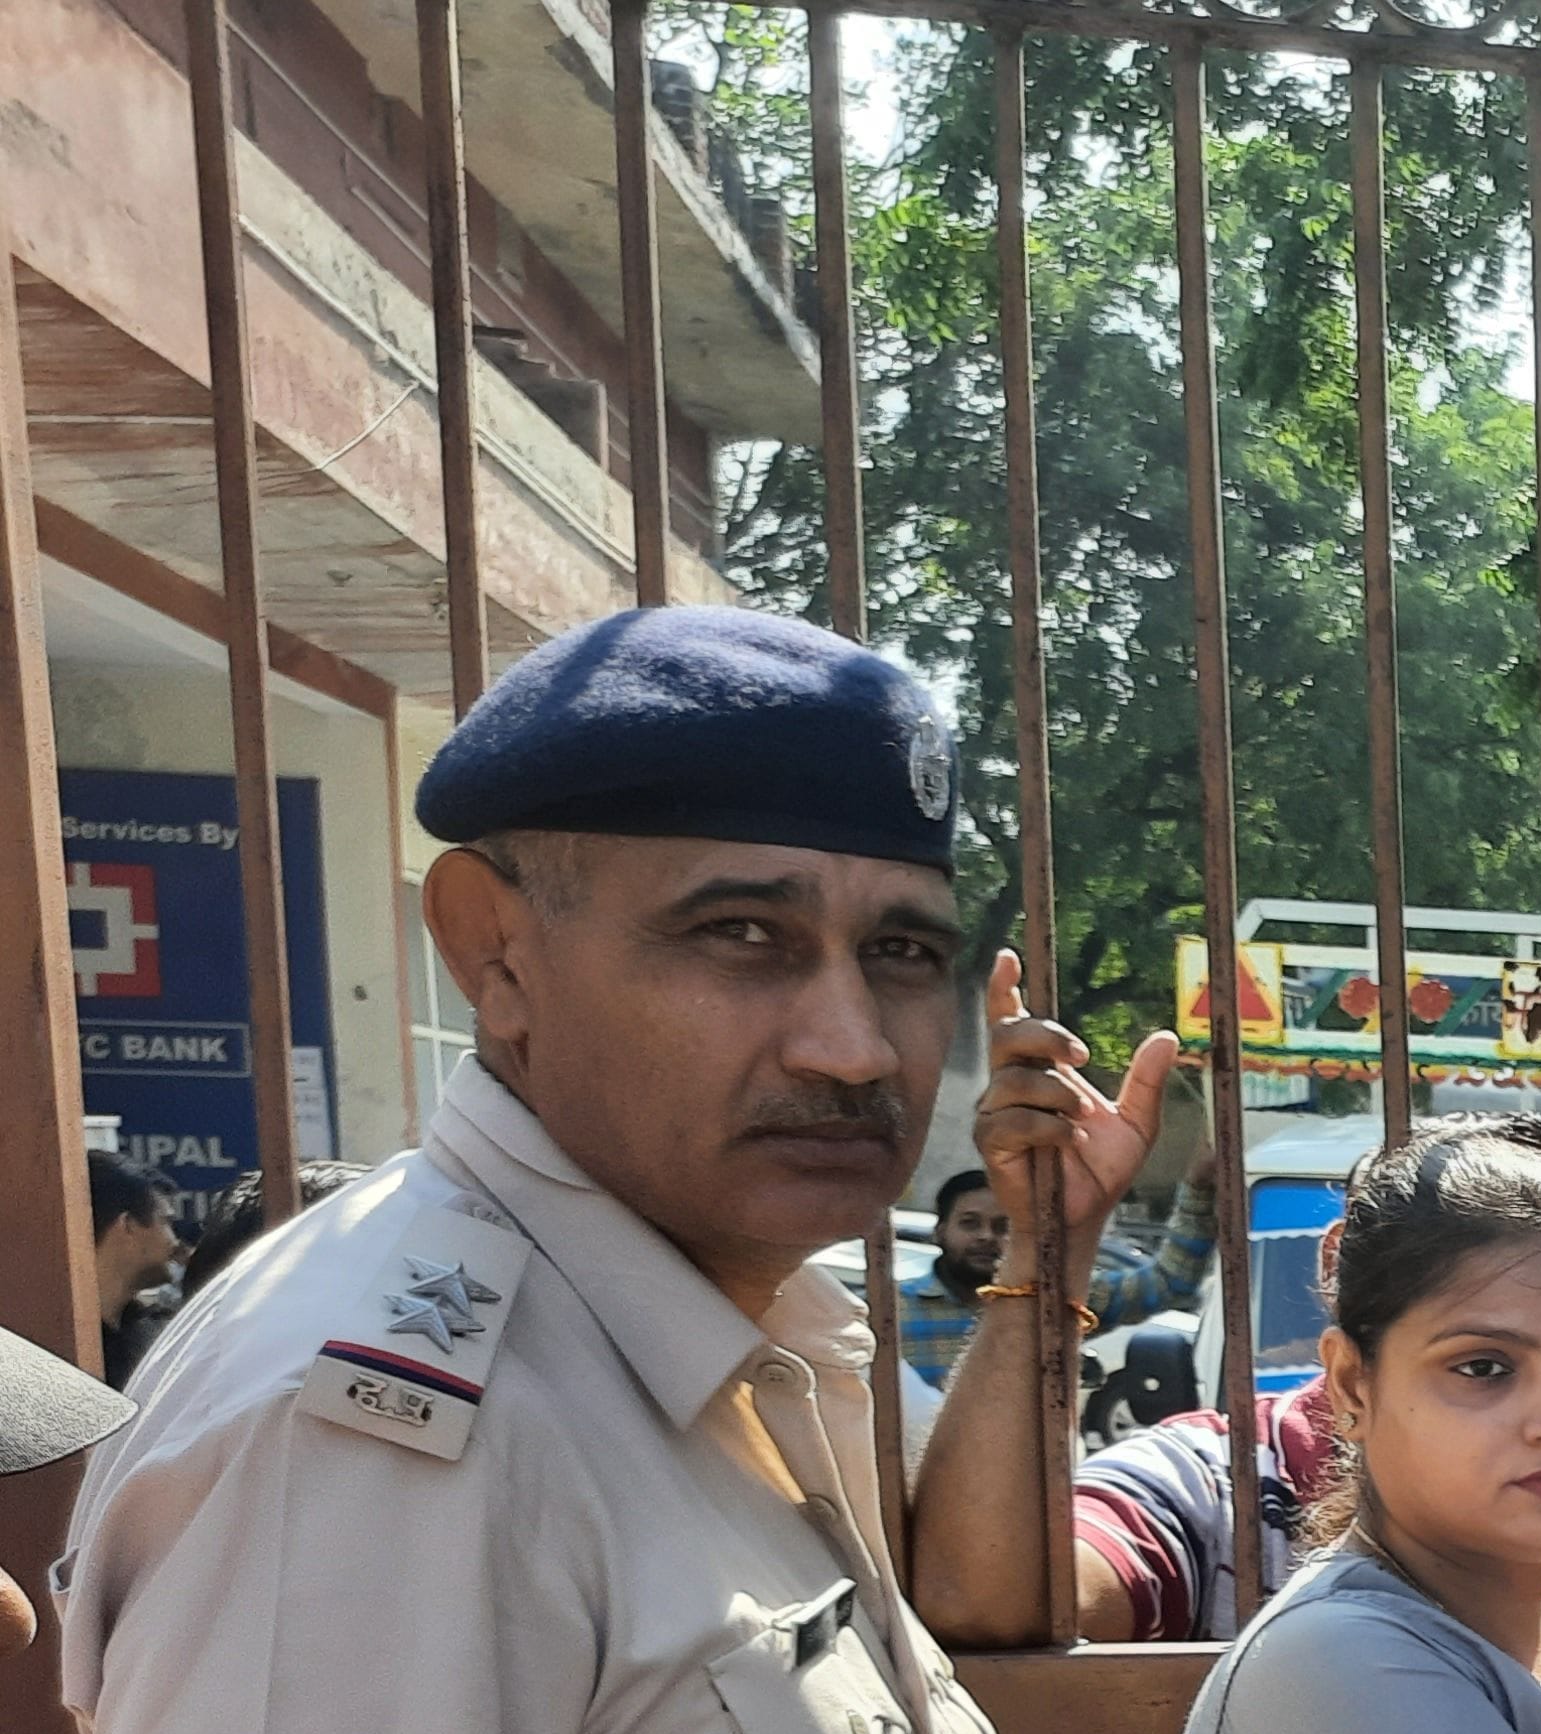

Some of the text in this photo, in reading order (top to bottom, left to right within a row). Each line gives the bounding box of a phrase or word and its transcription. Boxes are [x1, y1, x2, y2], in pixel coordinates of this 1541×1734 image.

[62, 815, 240, 851] Services By
[121, 1033, 228, 1063] BANK
